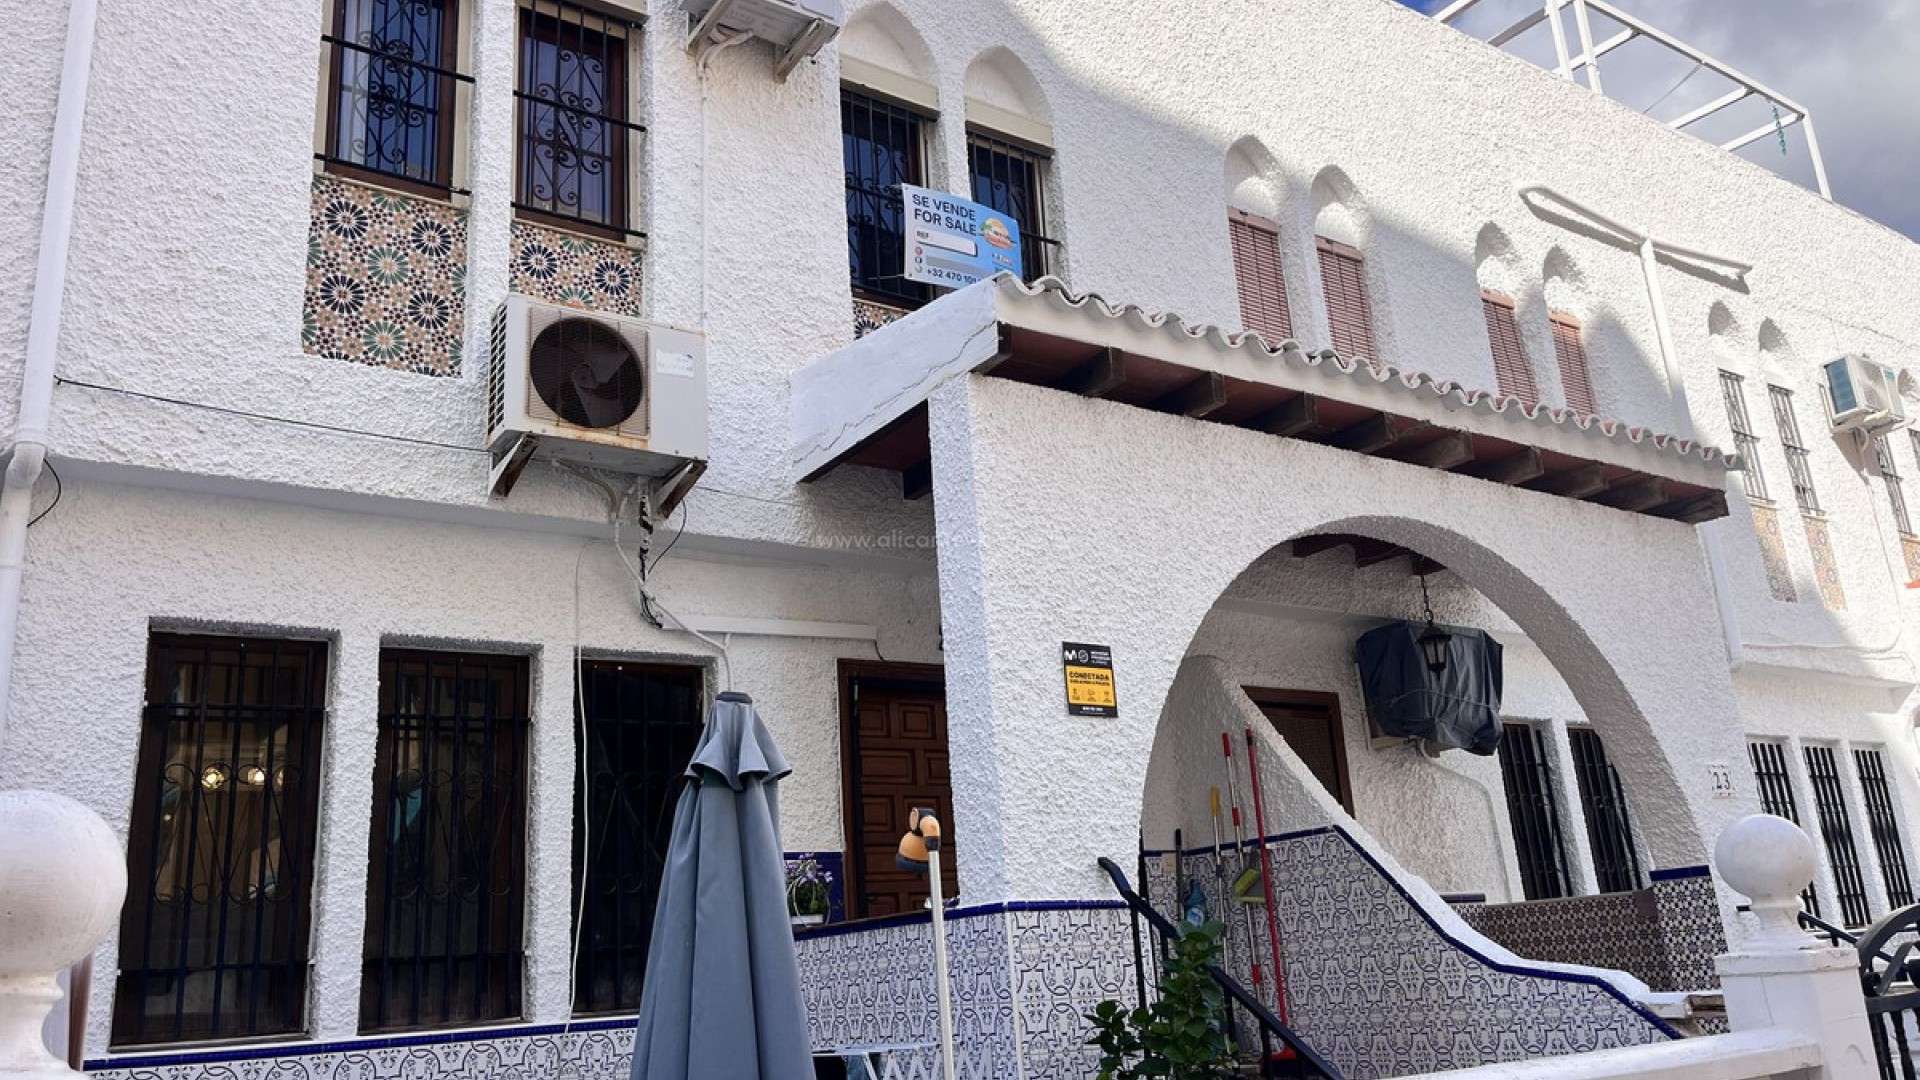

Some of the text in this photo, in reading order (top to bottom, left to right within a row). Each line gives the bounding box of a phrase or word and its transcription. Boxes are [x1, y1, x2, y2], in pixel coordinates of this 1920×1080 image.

[912, 194, 976, 222] SE VENDE
[914, 208, 942, 226] FOR
[945, 216, 977, 237] SALE
